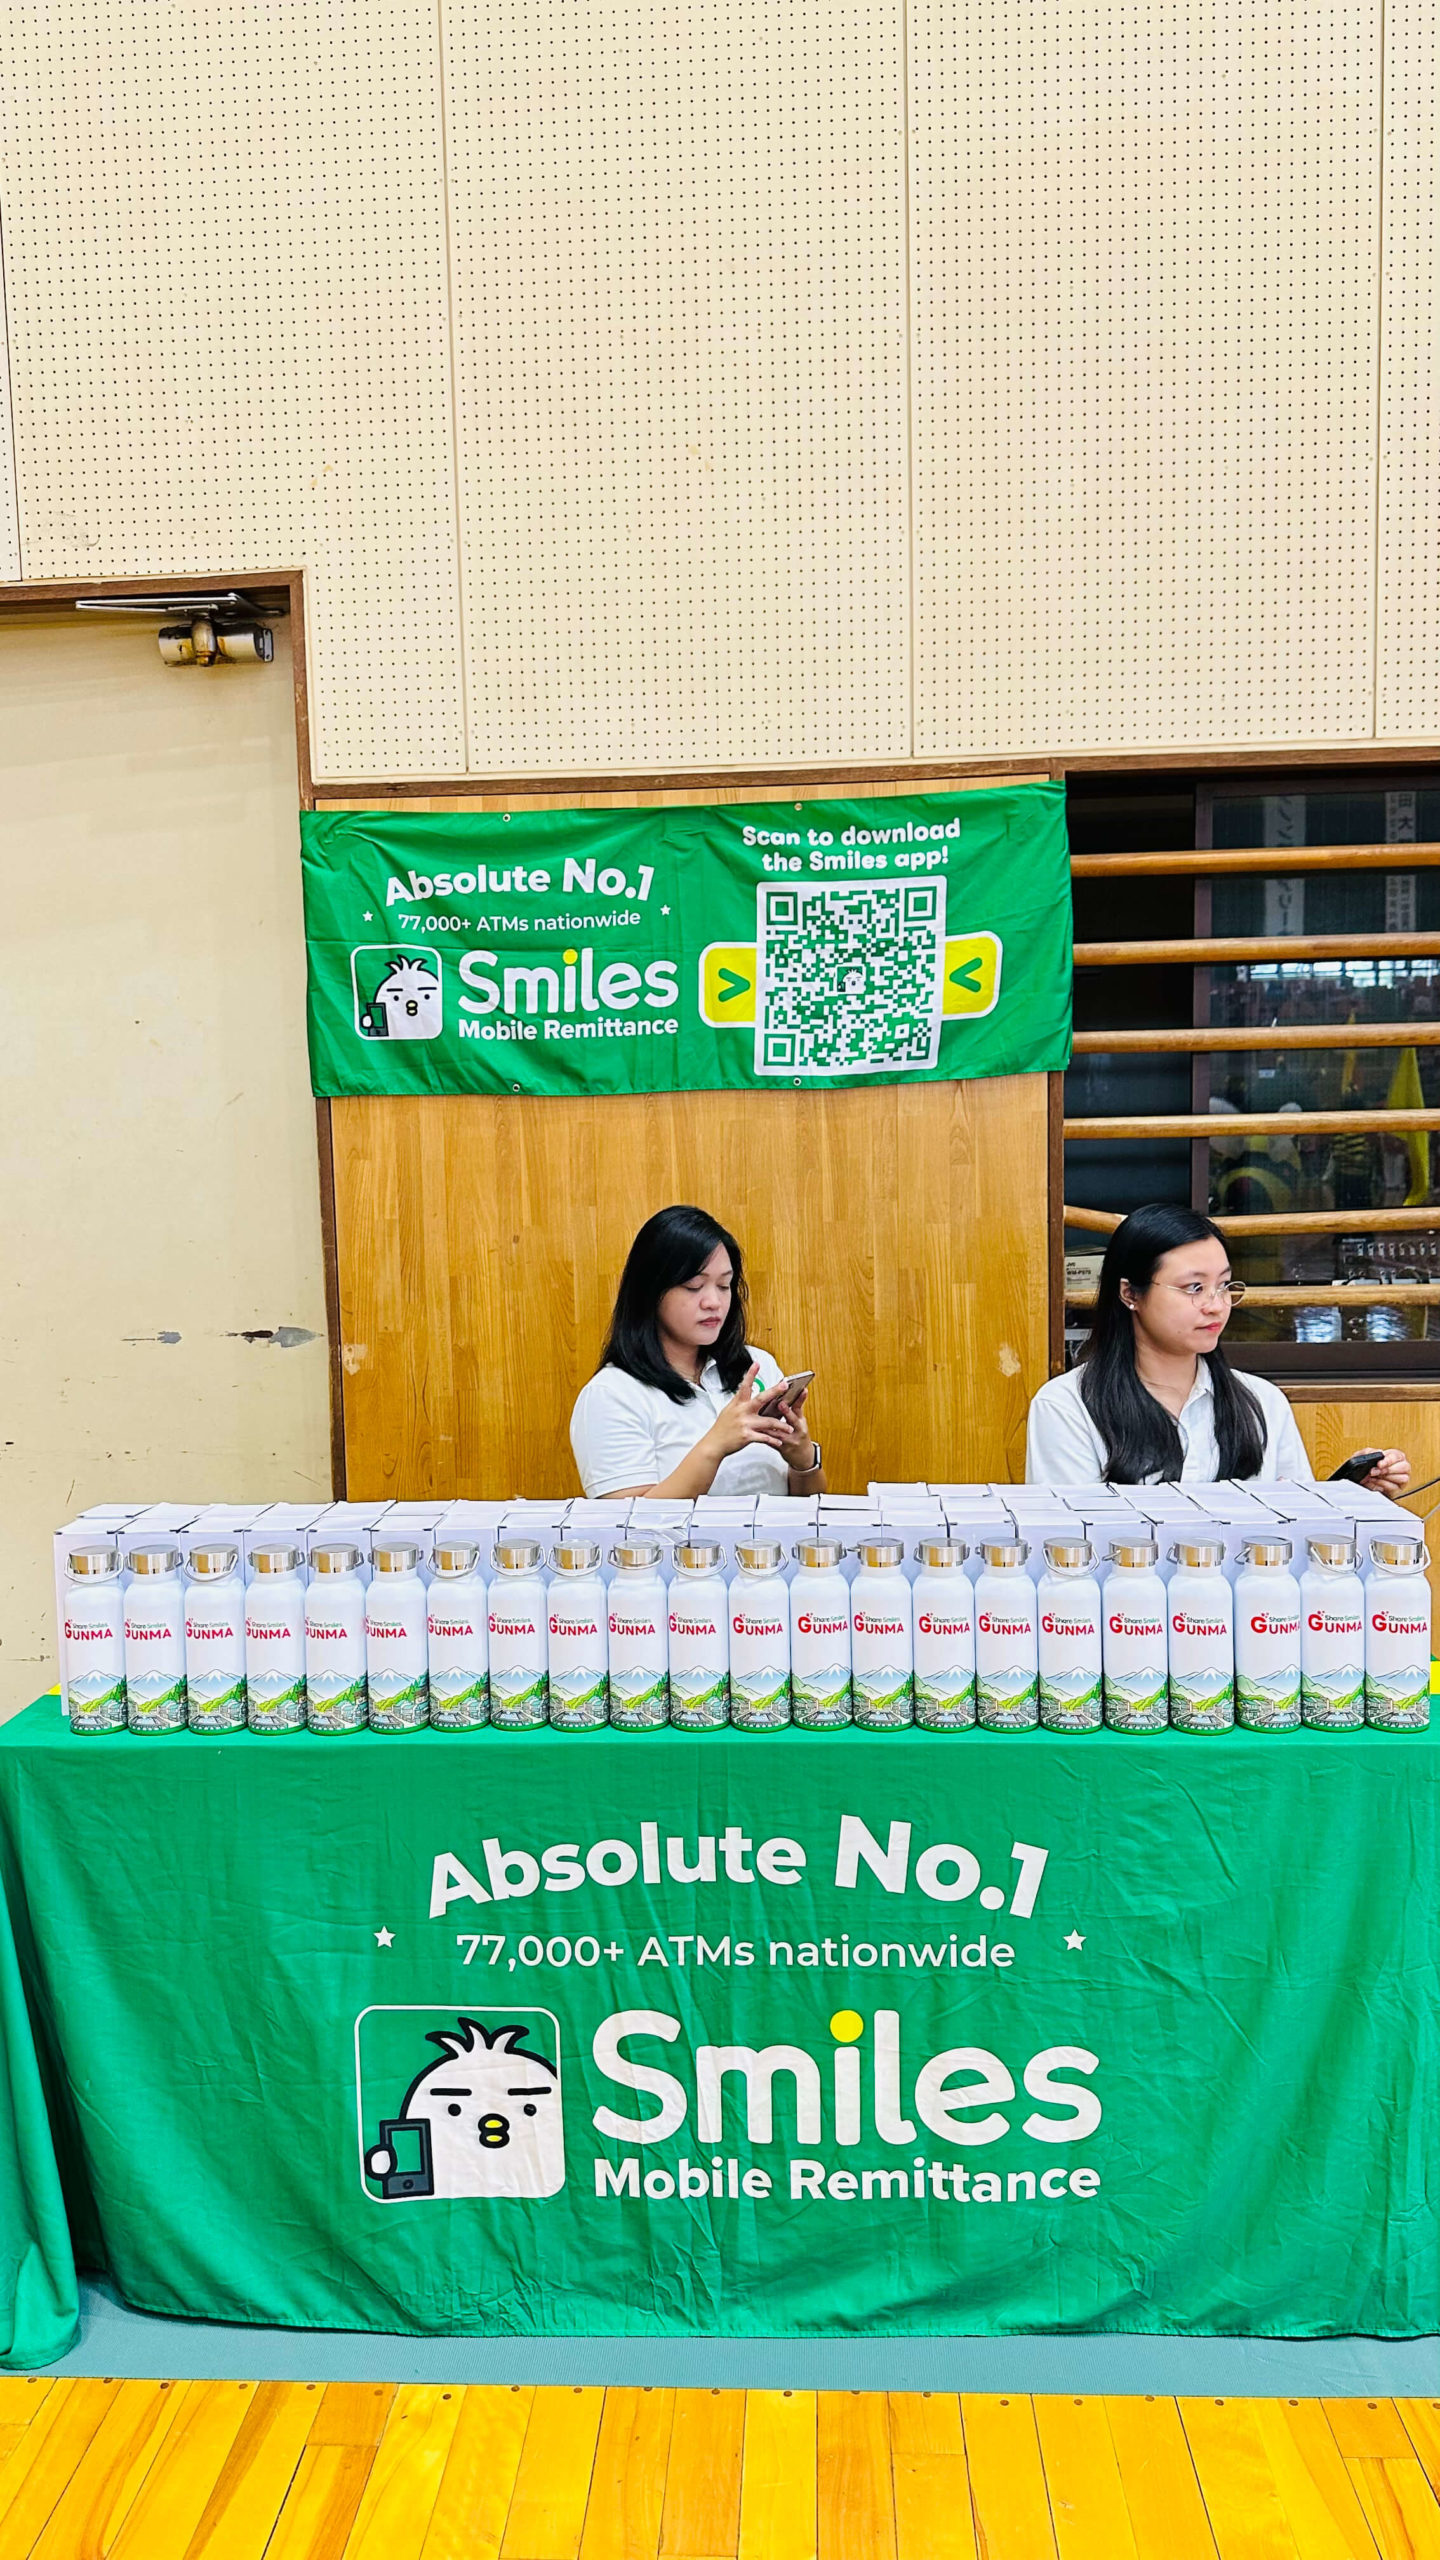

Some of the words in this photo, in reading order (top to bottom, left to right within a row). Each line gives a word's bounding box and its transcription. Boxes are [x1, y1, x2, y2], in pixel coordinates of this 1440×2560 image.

[743, 826, 800, 845] Scan
[807, 829, 833, 846] to
[841, 818, 960, 845] download
[762, 852, 802, 871] the
[810, 850, 887, 871] Smiles
[895, 846, 948, 871] app!
[386, 865, 550, 906] Absolute
[563, 858, 654, 900] No.1
[399, 914, 470, 933] 77,000+
[477, 917, 528, 931] ATMs
[535, 910, 640, 930] nationwide
[458, 948, 678, 1014] Smiles
[459, 1019, 537, 1040] Mobile
[544, 1017, 678, 1039] Remittance
[65, 1622, 113, 1640] GUNMA
[489, 1616, 535, 1635] GUNMA
[549, 1617, 597, 1635] GUNMA
[609, 1616, 655, 1635] GUNMA
[669, 1615, 716, 1635] GUNMA
[733, 1617, 783, 1635] GUNMA
[798, 1616, 848, 1634] GUNMA
[854, 1615, 904, 1634] GUNMA
[919, 1616, 970, 1634] GUNMA
[979, 1615, 1031, 1635] GUNMA
[1042, 1616, 1095, 1635] GUNMA
[1110, 1616, 1163, 1636] GUNMA
[1173, 1616, 1227, 1635] GUNMA
[1308, 1614, 1362, 1633] GUNMA
[1372, 1614, 1427, 1633] GUNMA
[430, 1822, 806, 1918] Absolute
[835, 1815, 1048, 1918] No.1
[457, 1935, 623, 1971] 77,000+
[638, 1936, 754, 1966] ATMs
[770, 1934, 1014, 1967] nationwide
[593, 2010, 1101, 2145] Smiles
[595, 2156, 772, 2199] Mobile
[790, 2157, 1100, 2202] Remittance
